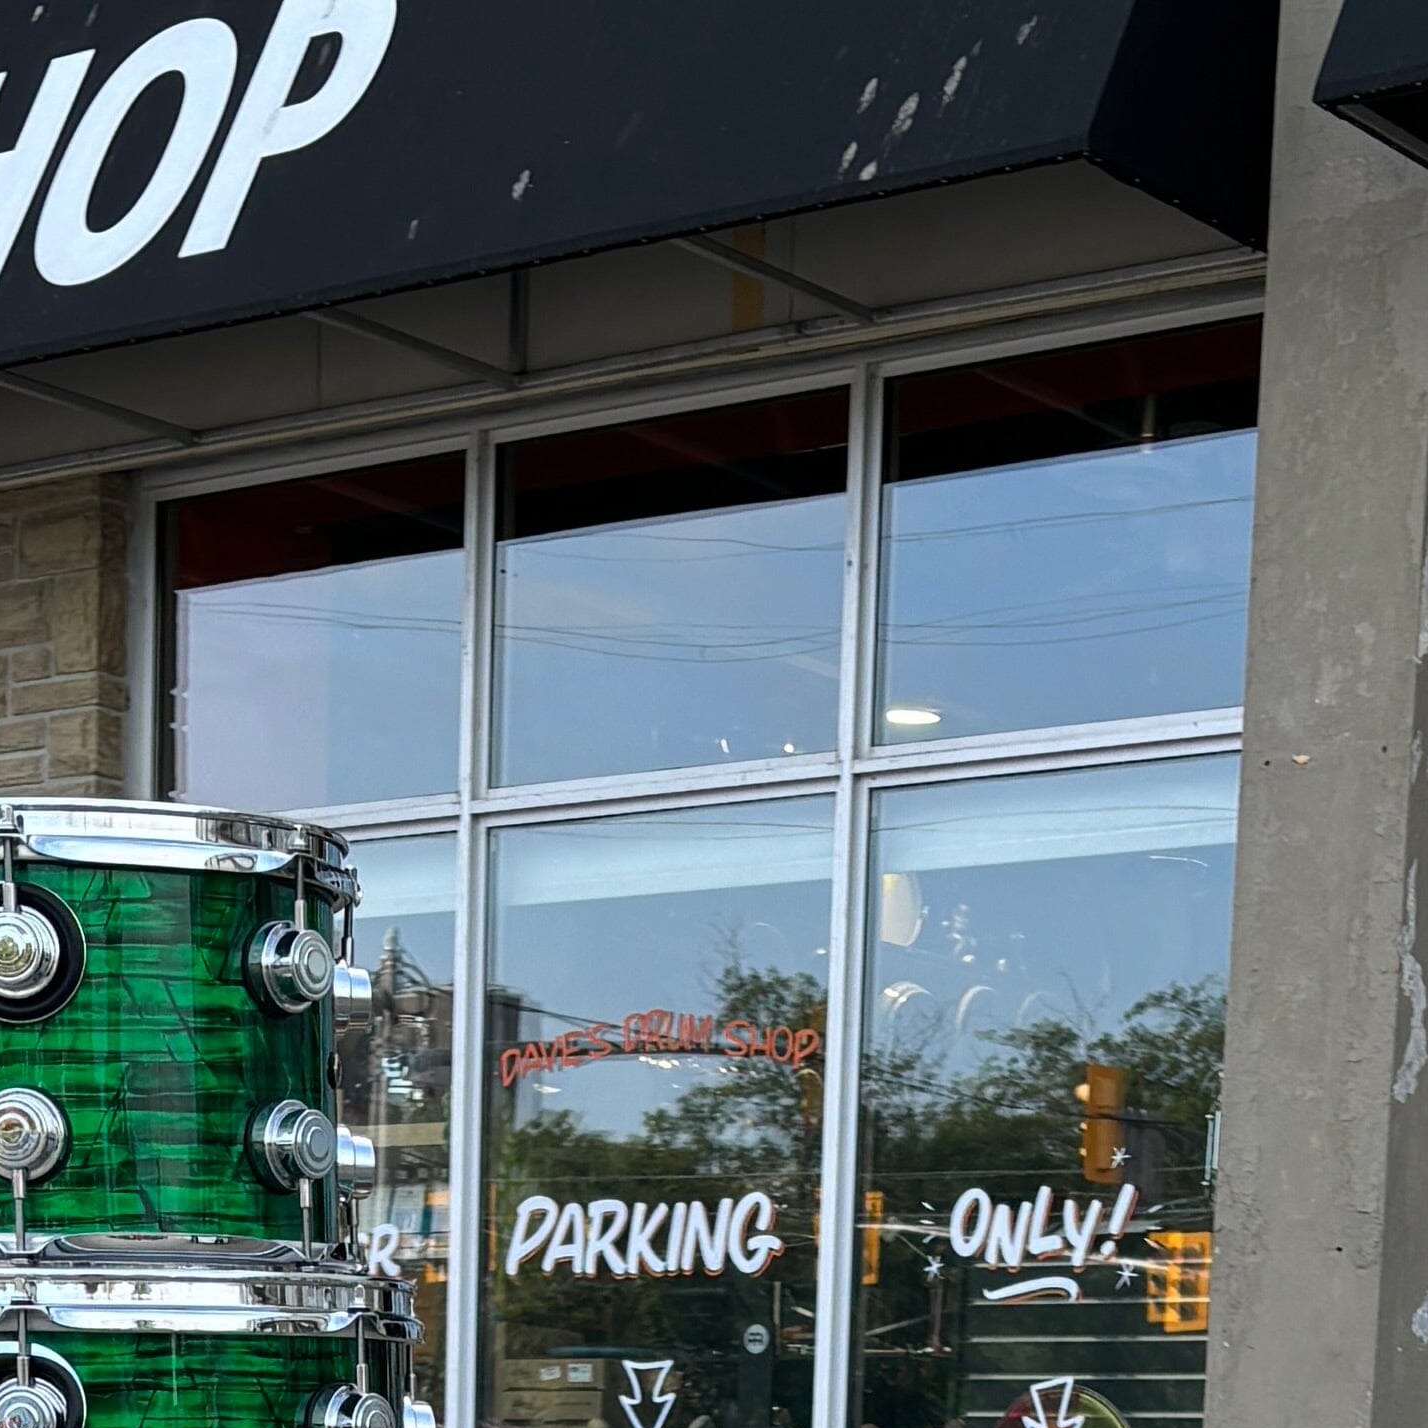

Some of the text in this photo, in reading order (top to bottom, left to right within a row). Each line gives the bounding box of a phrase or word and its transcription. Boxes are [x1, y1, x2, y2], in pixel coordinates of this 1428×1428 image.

[724, 1020, 820, 1068] SHOP
[505, 1191, 785, 1280] PARKING
[949, 1183, 1137, 1271] ONLY!
